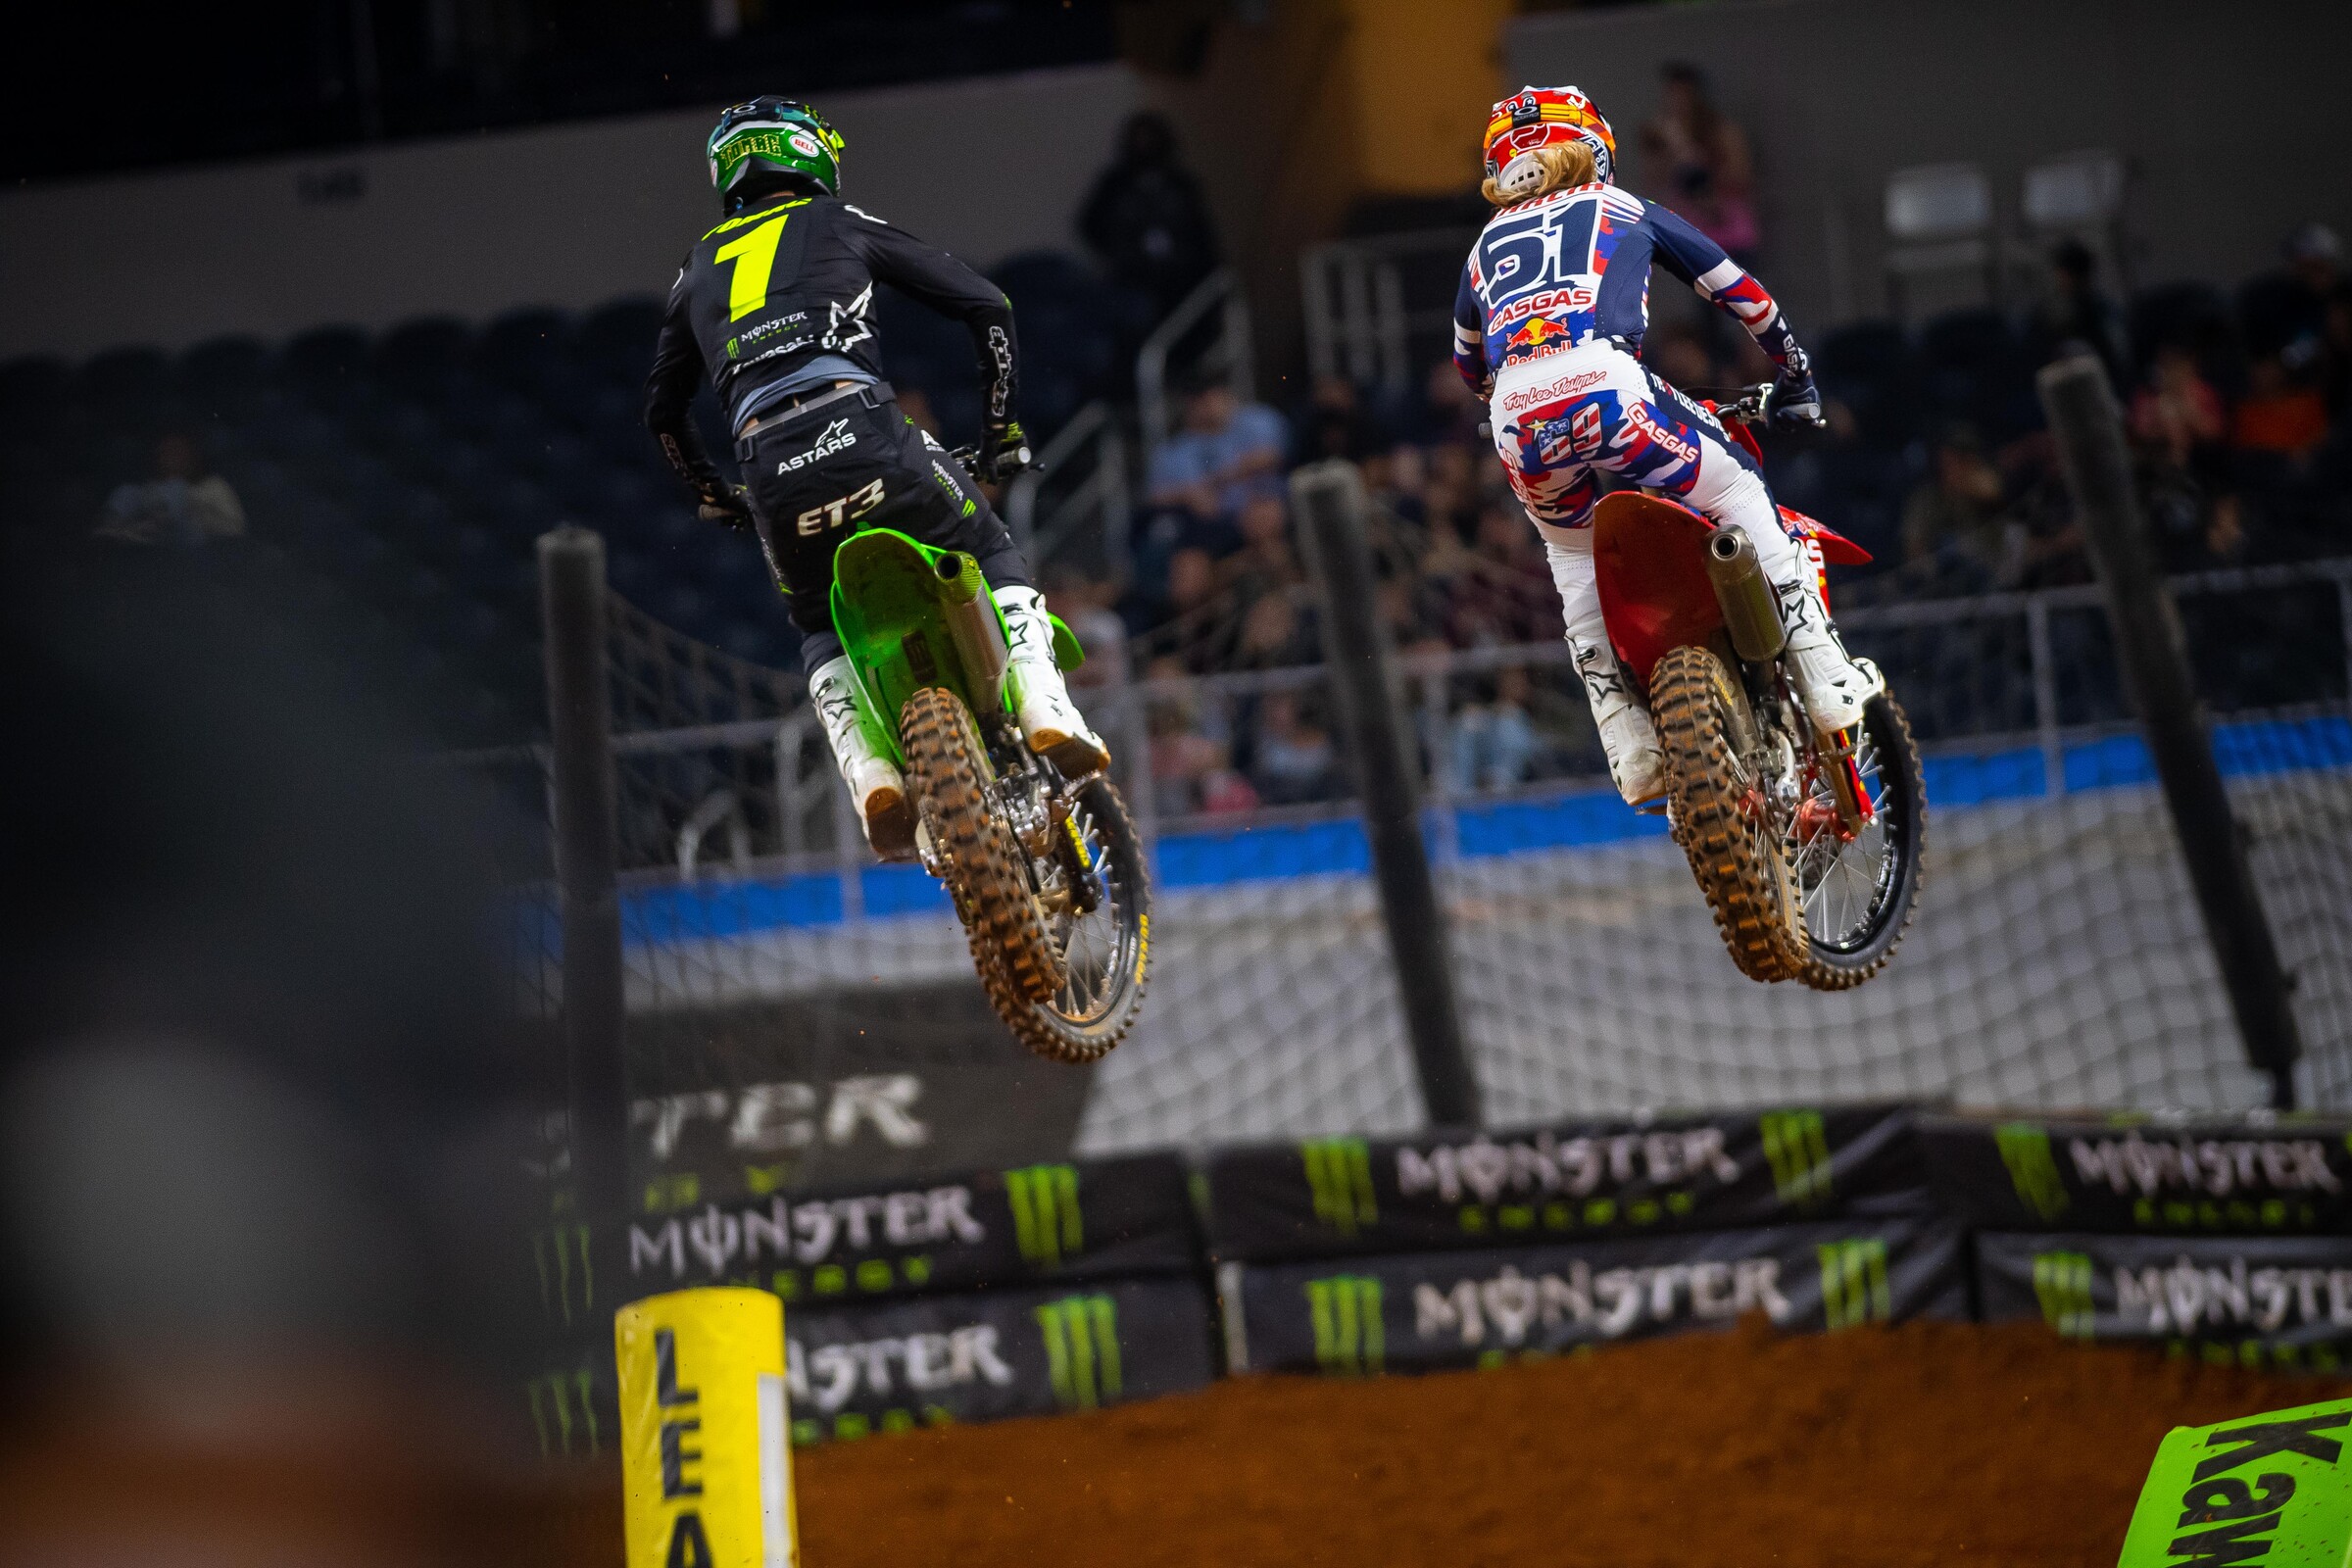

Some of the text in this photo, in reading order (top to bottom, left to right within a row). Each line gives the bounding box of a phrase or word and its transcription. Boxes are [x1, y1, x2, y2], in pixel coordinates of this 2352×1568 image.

[794, 138, 815, 154] BELL
[713, 214, 789, 323] 1
[740, 311, 808, 342] MONSTER
[1490, 290, 1592, 334] GASGAS
[1503, 371, 1606, 412] Troy Lee Designs
[777, 432, 857, 475] ASTARS
[1538, 402, 1602, 466] 69
[1627, 403, 1698, 464] GASGAS
[798, 477, 886, 536] ET3
